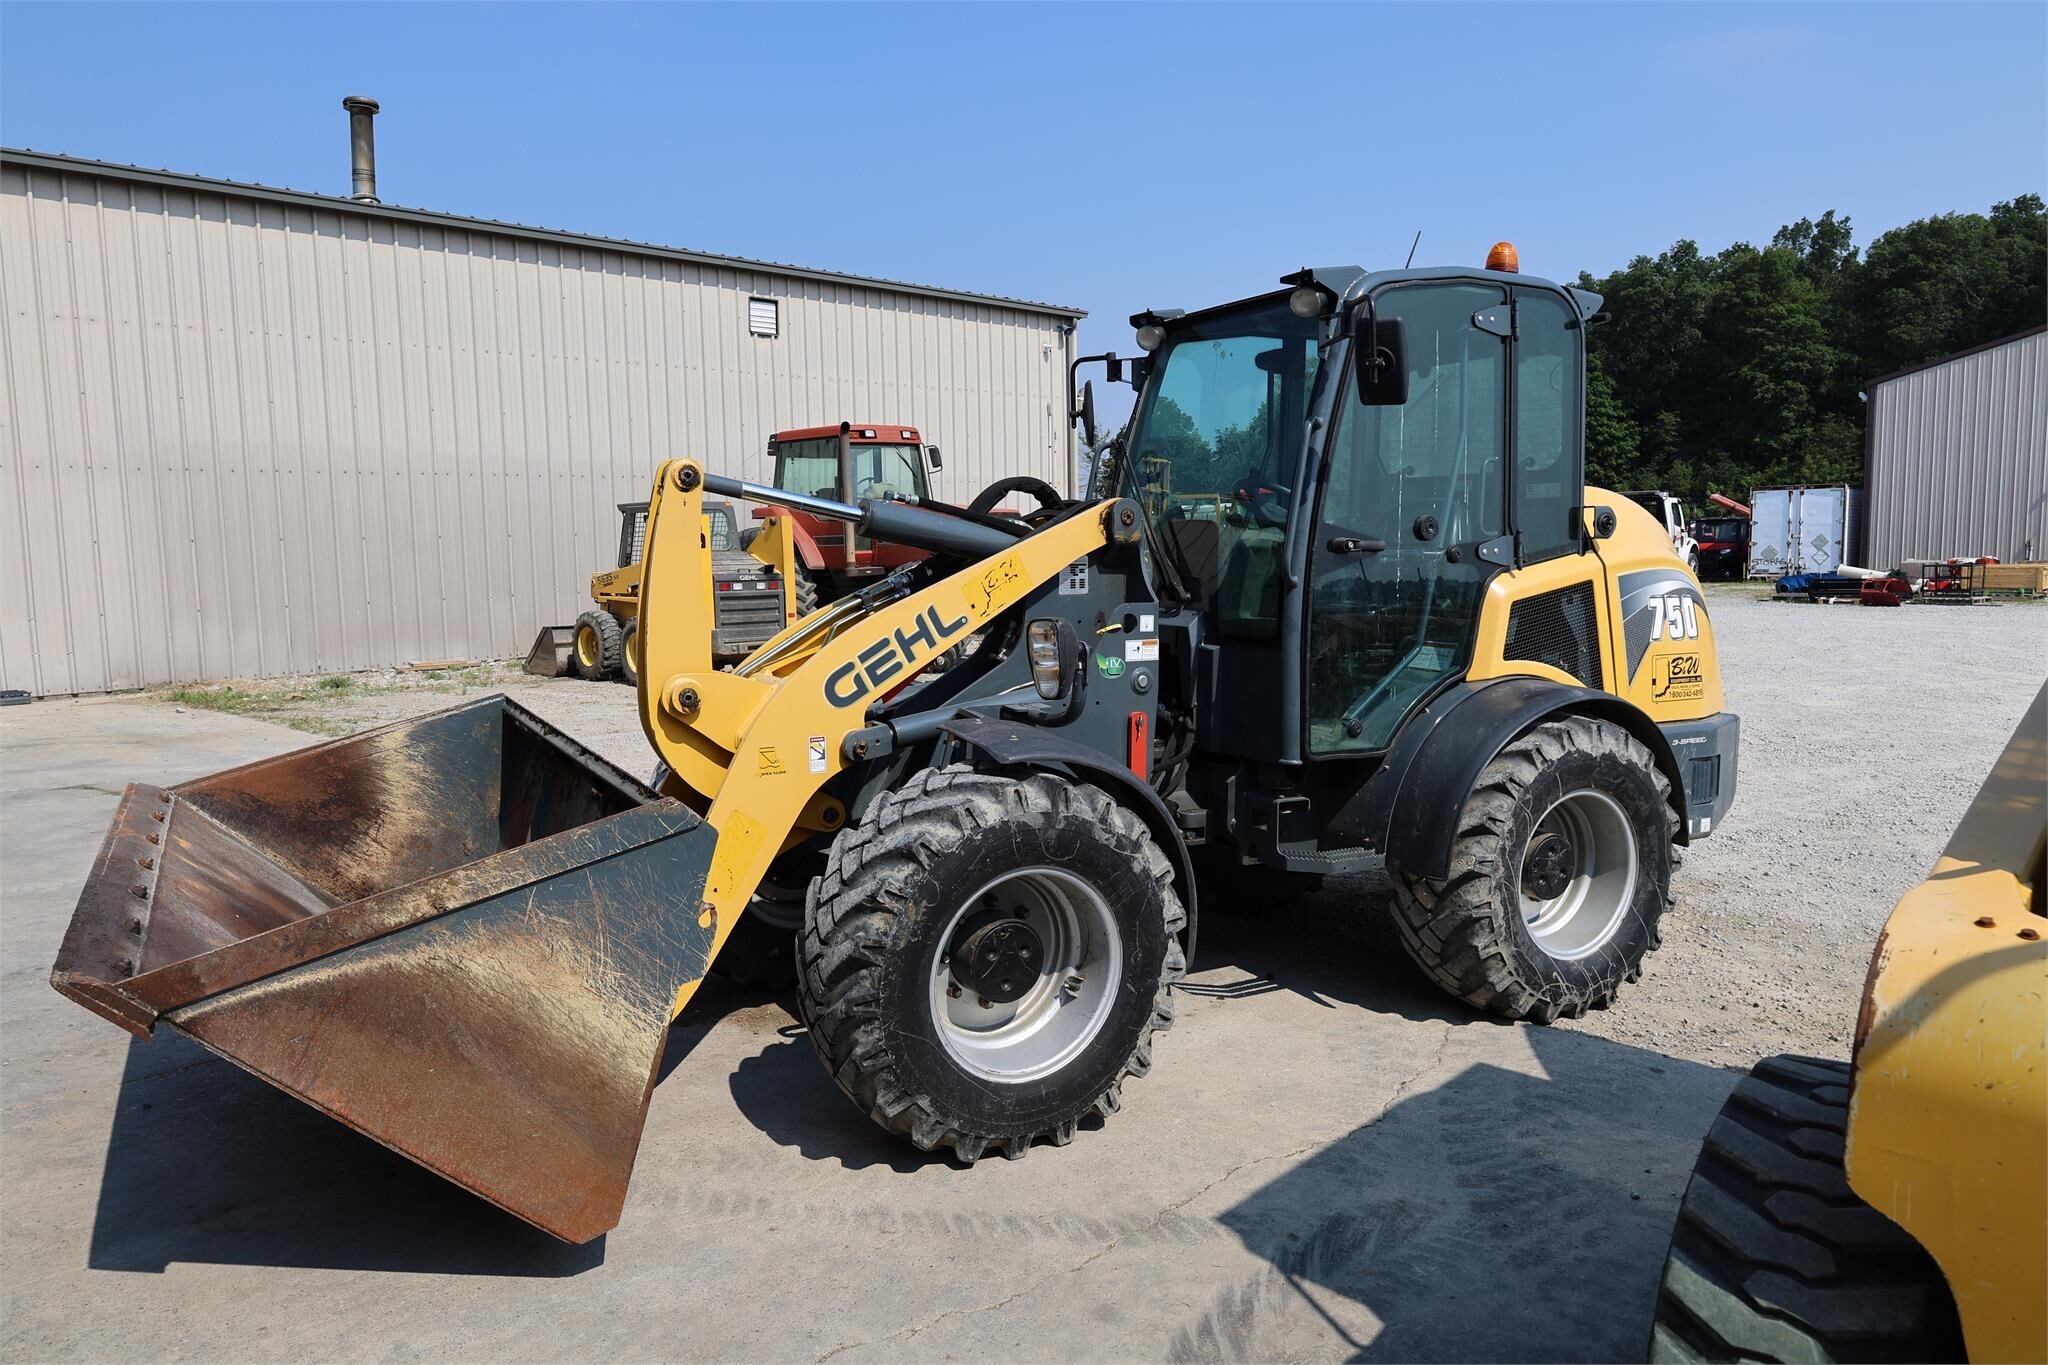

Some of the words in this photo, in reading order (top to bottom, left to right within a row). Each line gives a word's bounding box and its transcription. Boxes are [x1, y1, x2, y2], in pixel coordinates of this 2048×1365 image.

[1648, 595, 1698, 642] 750
[824, 605, 968, 708] GEHL
[1672, 736, 1707, 745] 3-SPEED
